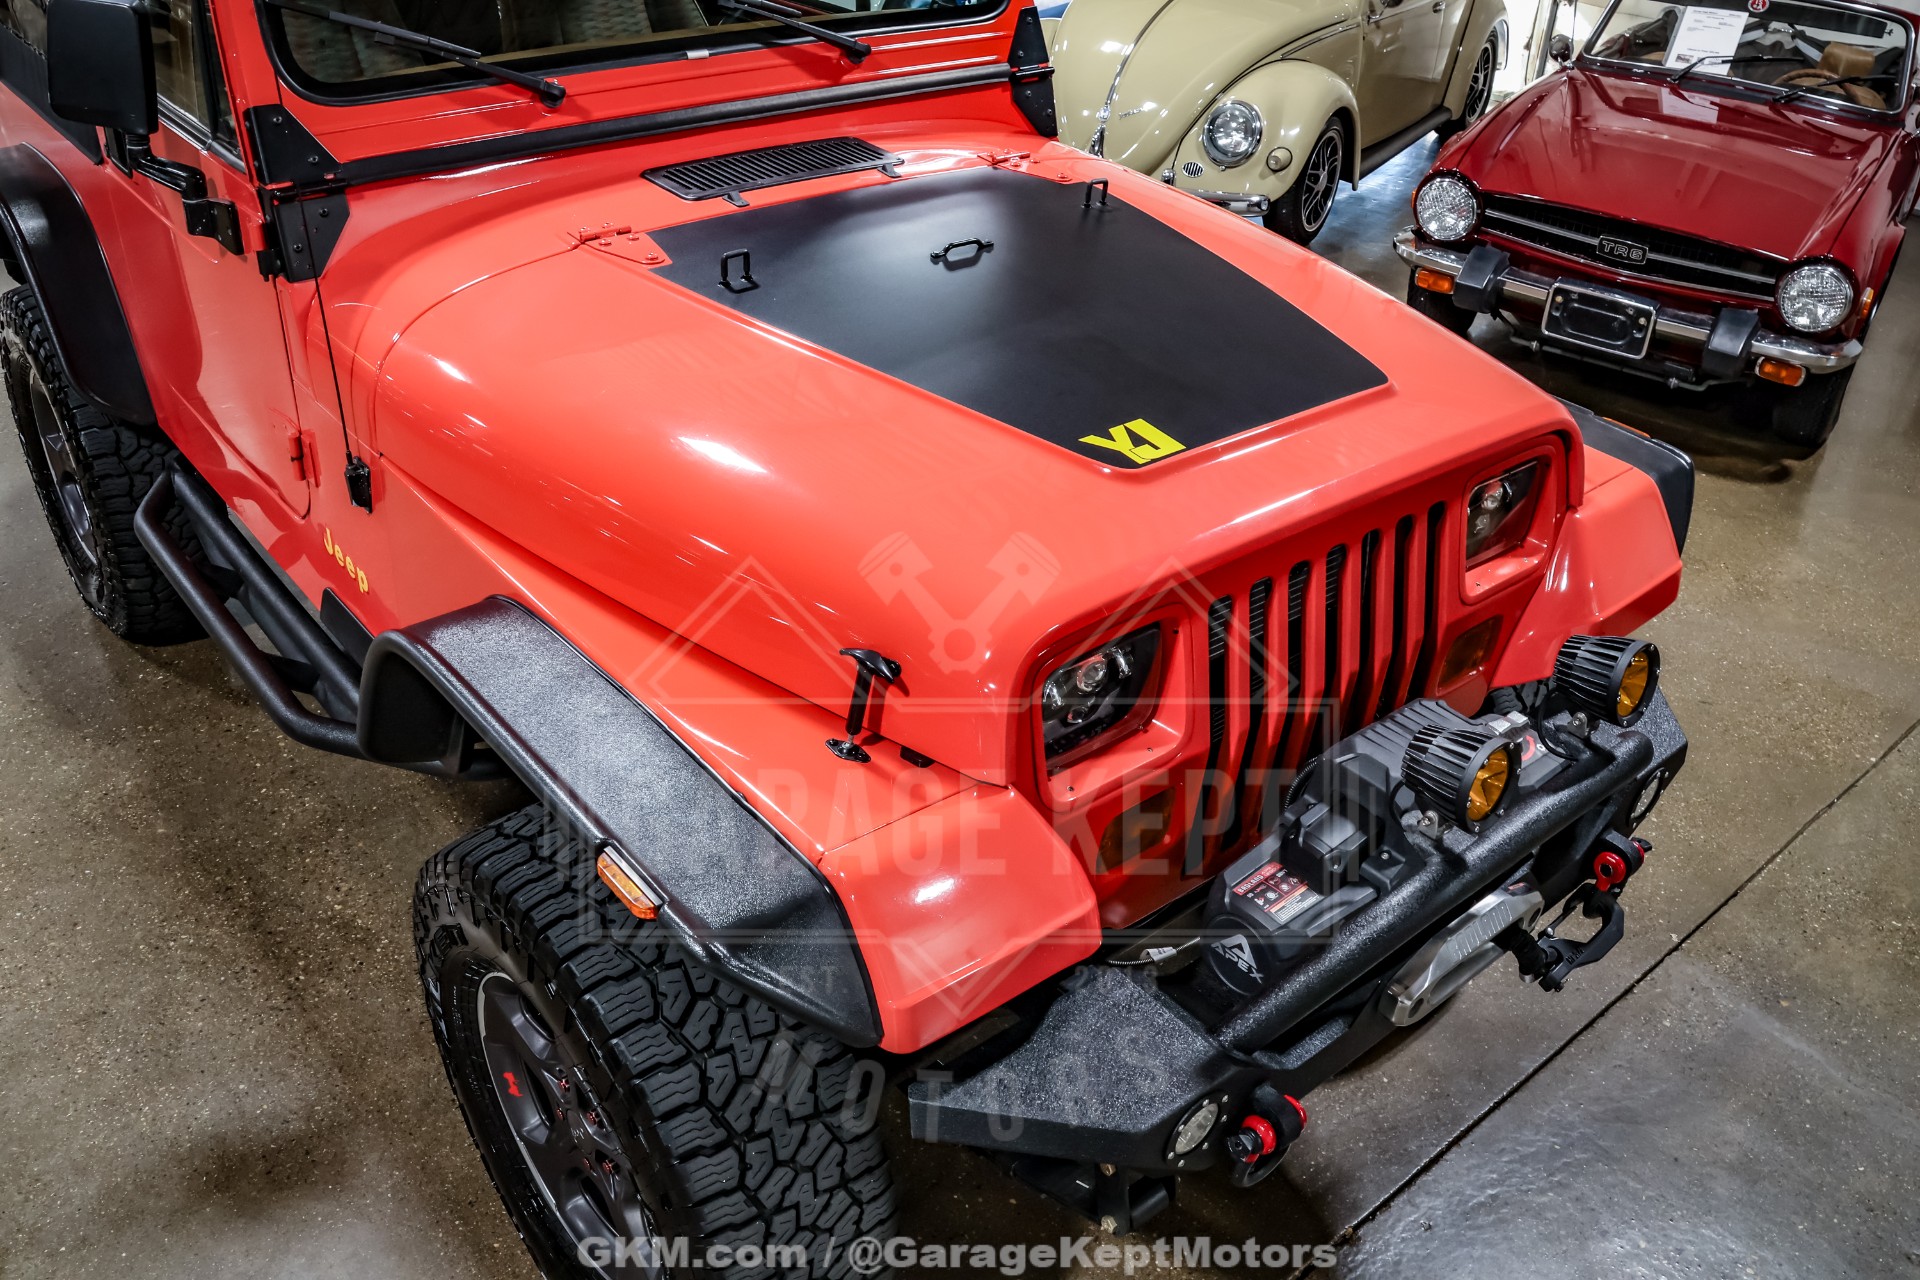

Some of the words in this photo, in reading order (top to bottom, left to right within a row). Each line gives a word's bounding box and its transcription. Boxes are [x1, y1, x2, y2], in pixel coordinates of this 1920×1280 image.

[1602, 240, 1644, 260] TR6
[1078, 418, 1187, 464] YJ
[324, 527, 369, 593] Jeep
[1211, 934, 1264, 984] APEX
